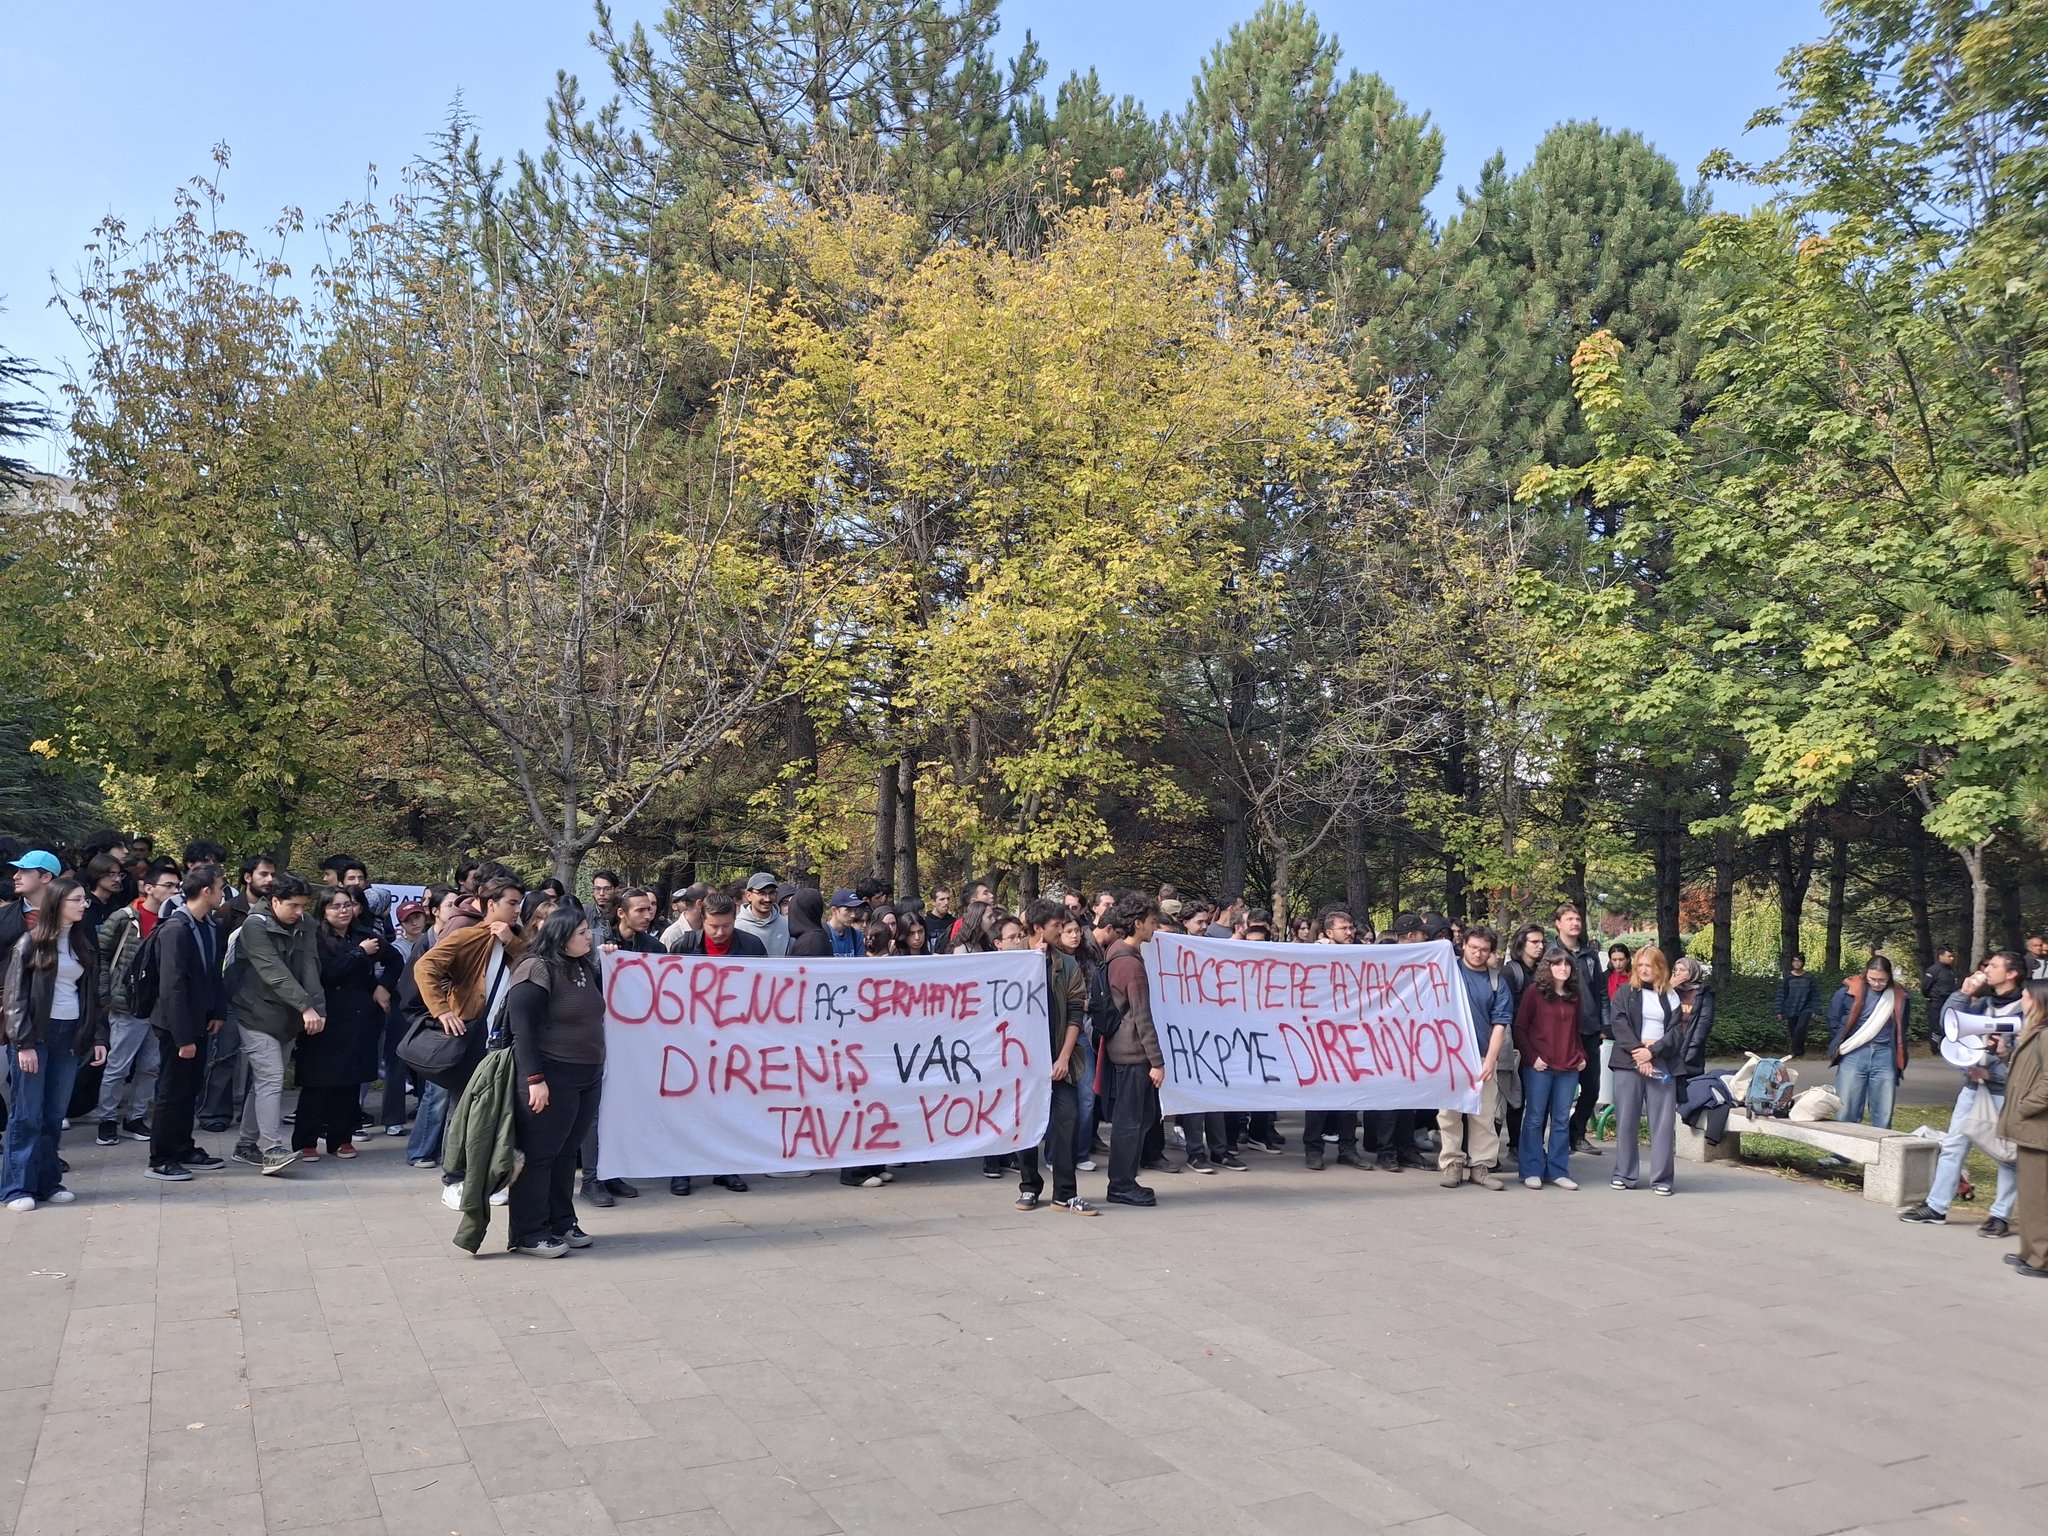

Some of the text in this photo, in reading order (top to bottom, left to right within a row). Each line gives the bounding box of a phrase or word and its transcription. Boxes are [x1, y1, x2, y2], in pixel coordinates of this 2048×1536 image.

[607, 953, 1046, 1029] ÖĞRENCİ AÇ SERMAYE TOK
[1156, 938, 1450, 1021] HACETTEPE AYAKTA
[660, 1035, 981, 1097] DİRENİŞ VAR
[1279, 1016, 1476, 1090] DİRENİYOR
[767, 1080, 1021, 1158] TAVİZ YOK!
